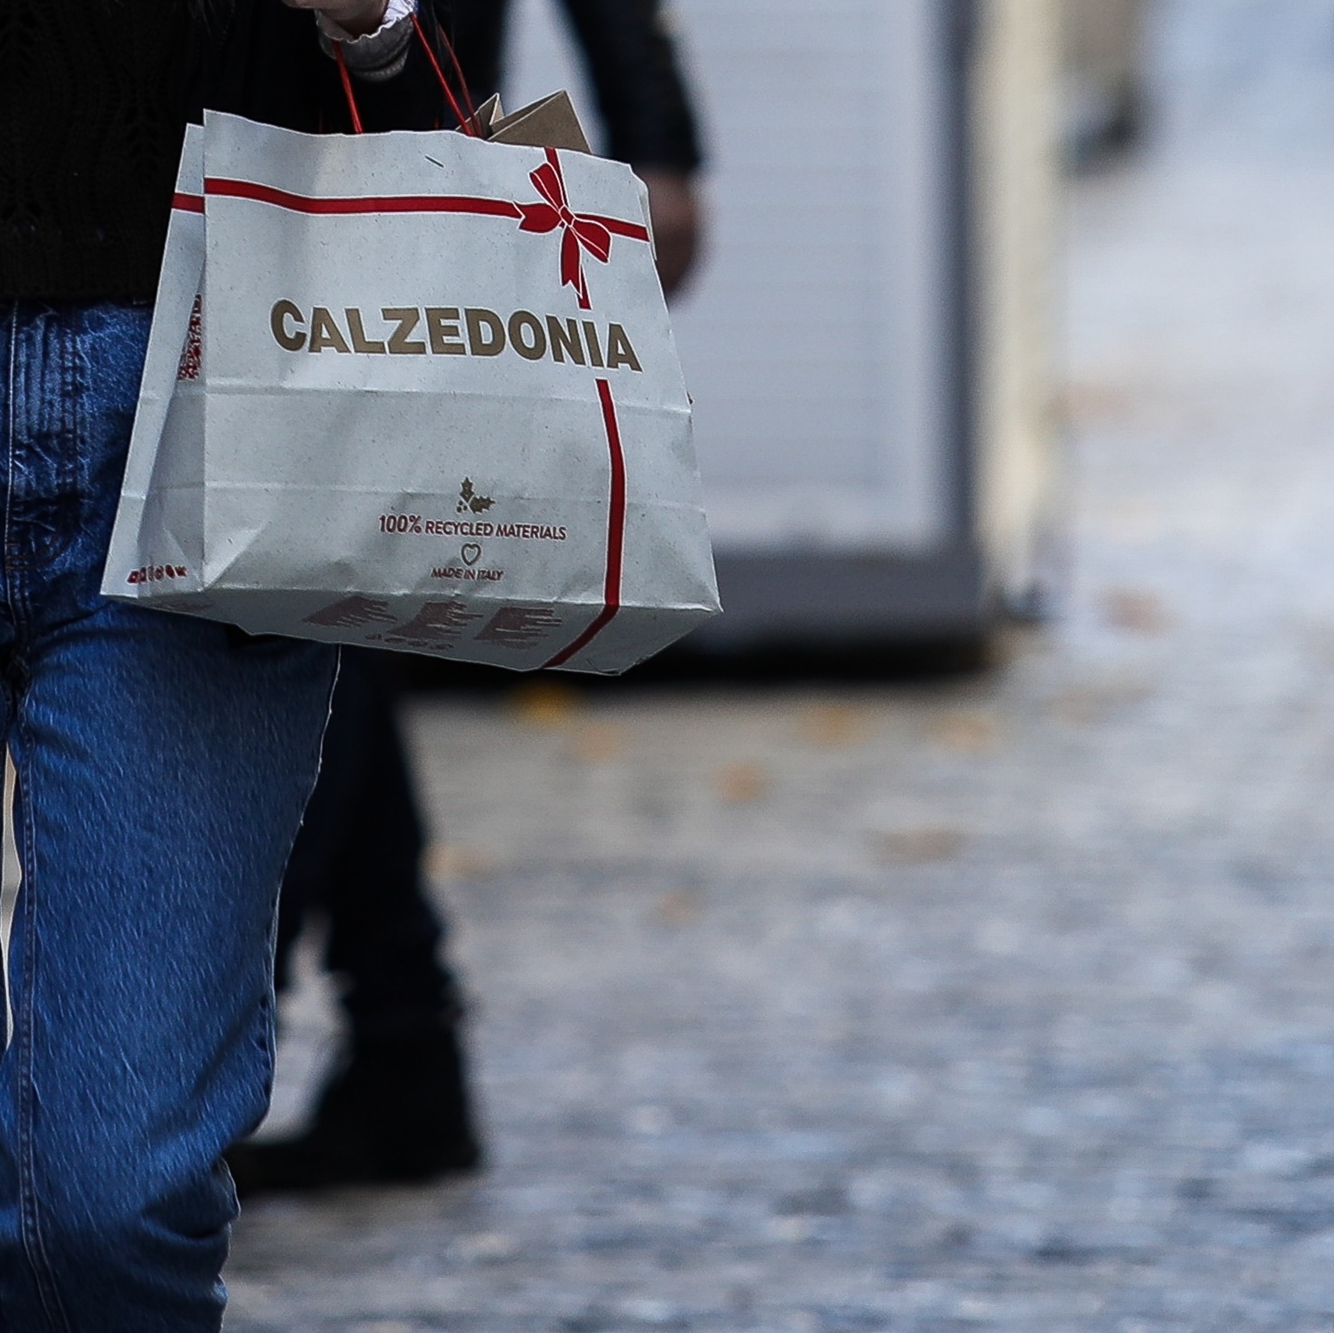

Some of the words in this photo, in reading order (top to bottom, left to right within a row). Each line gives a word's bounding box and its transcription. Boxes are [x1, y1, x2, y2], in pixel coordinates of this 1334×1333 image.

[270, 299, 643, 373] CALZEDONIA
[379, 515, 421, 533] 100%
[425, 521, 494, 537] RECYCLED
[496, 523, 567, 540] MATERIALS
[431, 568, 462, 579] MADE
[464, 569, 475, 579] IN
[477, 570, 504, 581] ITALY
